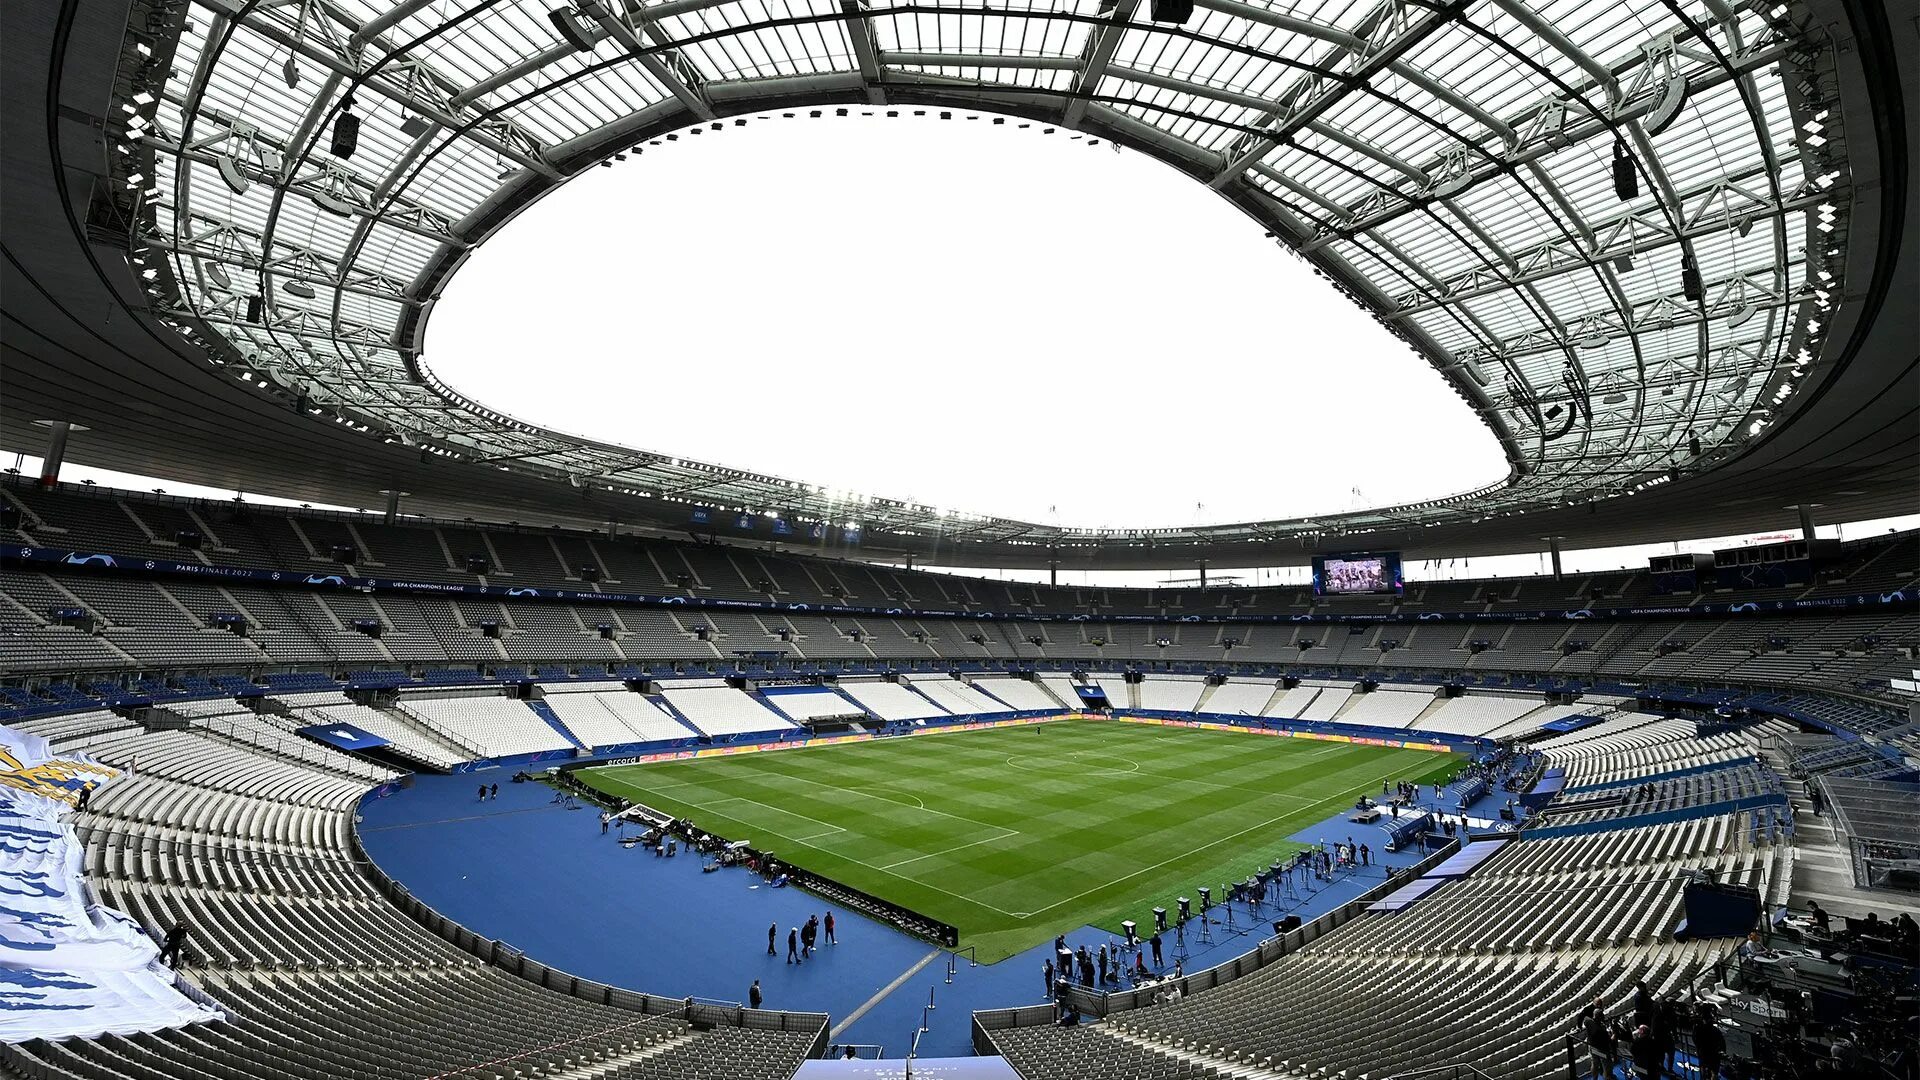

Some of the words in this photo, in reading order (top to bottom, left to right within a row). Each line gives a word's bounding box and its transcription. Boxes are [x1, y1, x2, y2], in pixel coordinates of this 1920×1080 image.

[176, 564, 199, 572] PARIS
[200, 566, 229, 575] FINALE
[232, 569, 253, 577] 2022
[409, 582, 442, 590] CHAMPIONS
[1731, 997, 1749, 1010] sky
